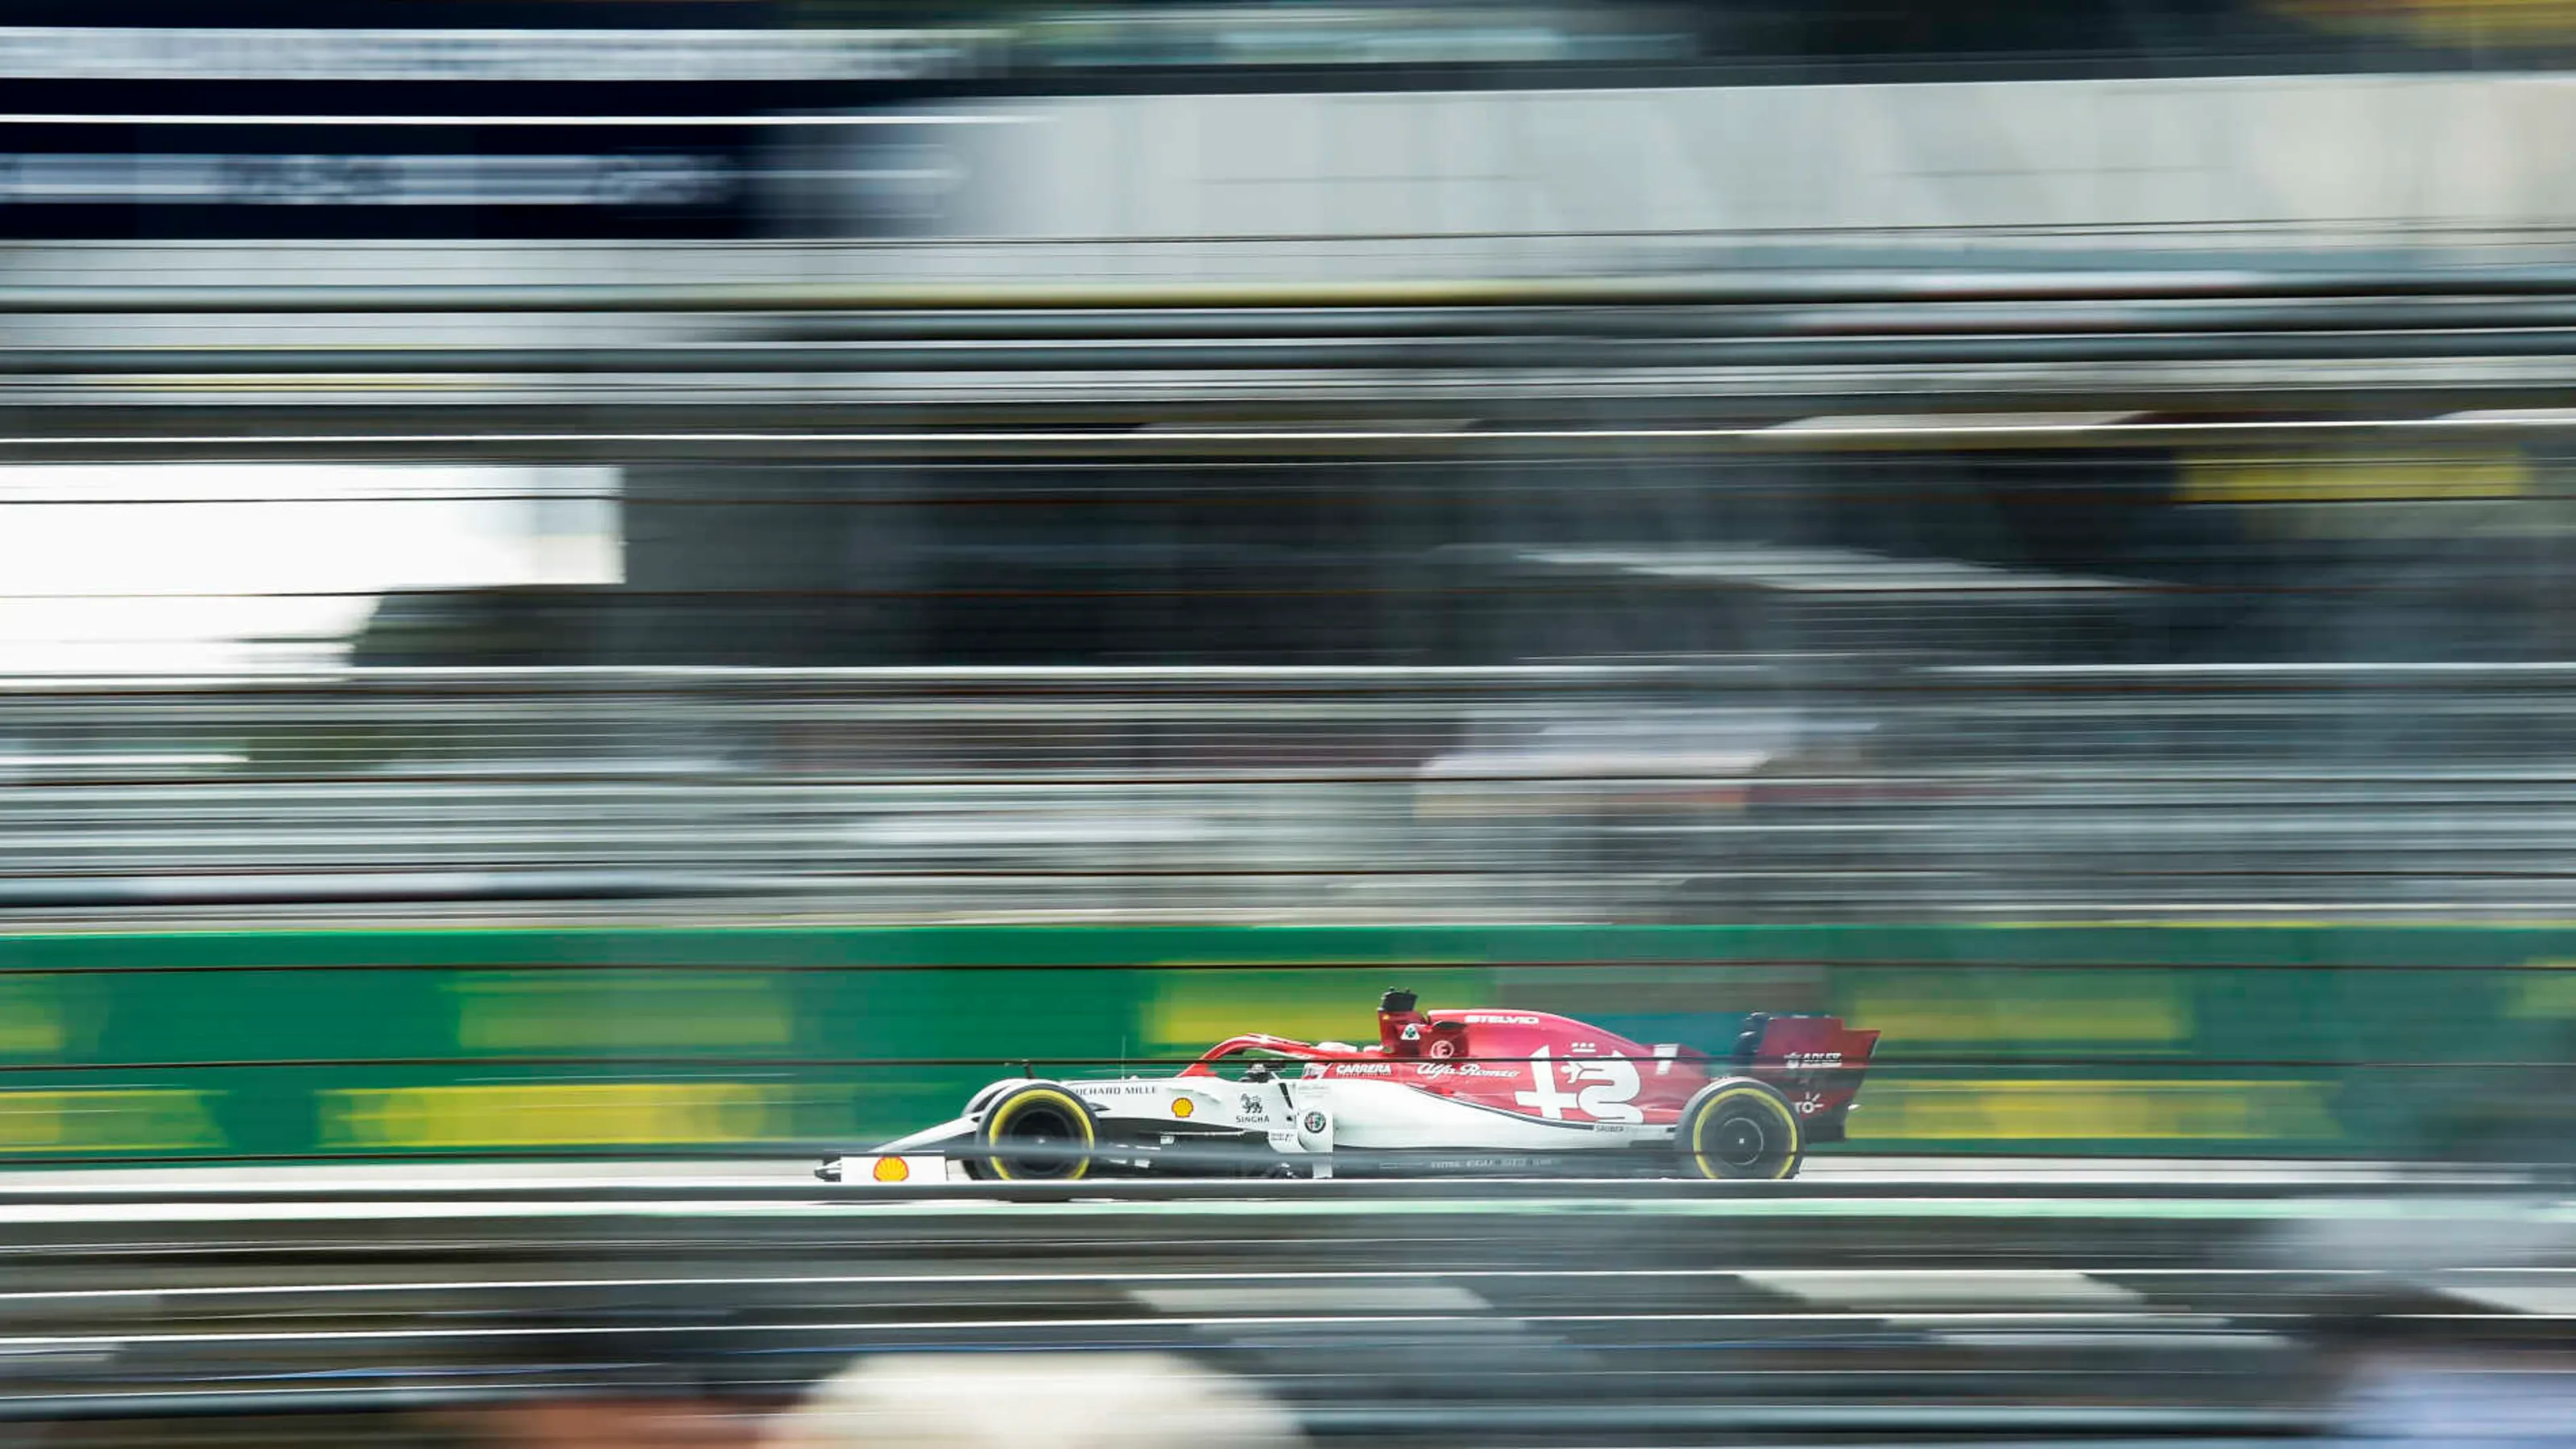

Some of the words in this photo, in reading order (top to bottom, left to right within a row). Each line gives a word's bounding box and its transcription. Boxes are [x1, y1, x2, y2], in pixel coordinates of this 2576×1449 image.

[1336, 1063, 1391, 1075] CARRERA
[1416, 1062, 1456, 1080] Alfa
[1458, 1063, 1520, 1077] Romeo
[1076, 1087, 1121, 1096] ICHARD
[1125, 1086, 1156, 1095] MILLE
[1235, 1115, 1270, 1124] SINGHA
